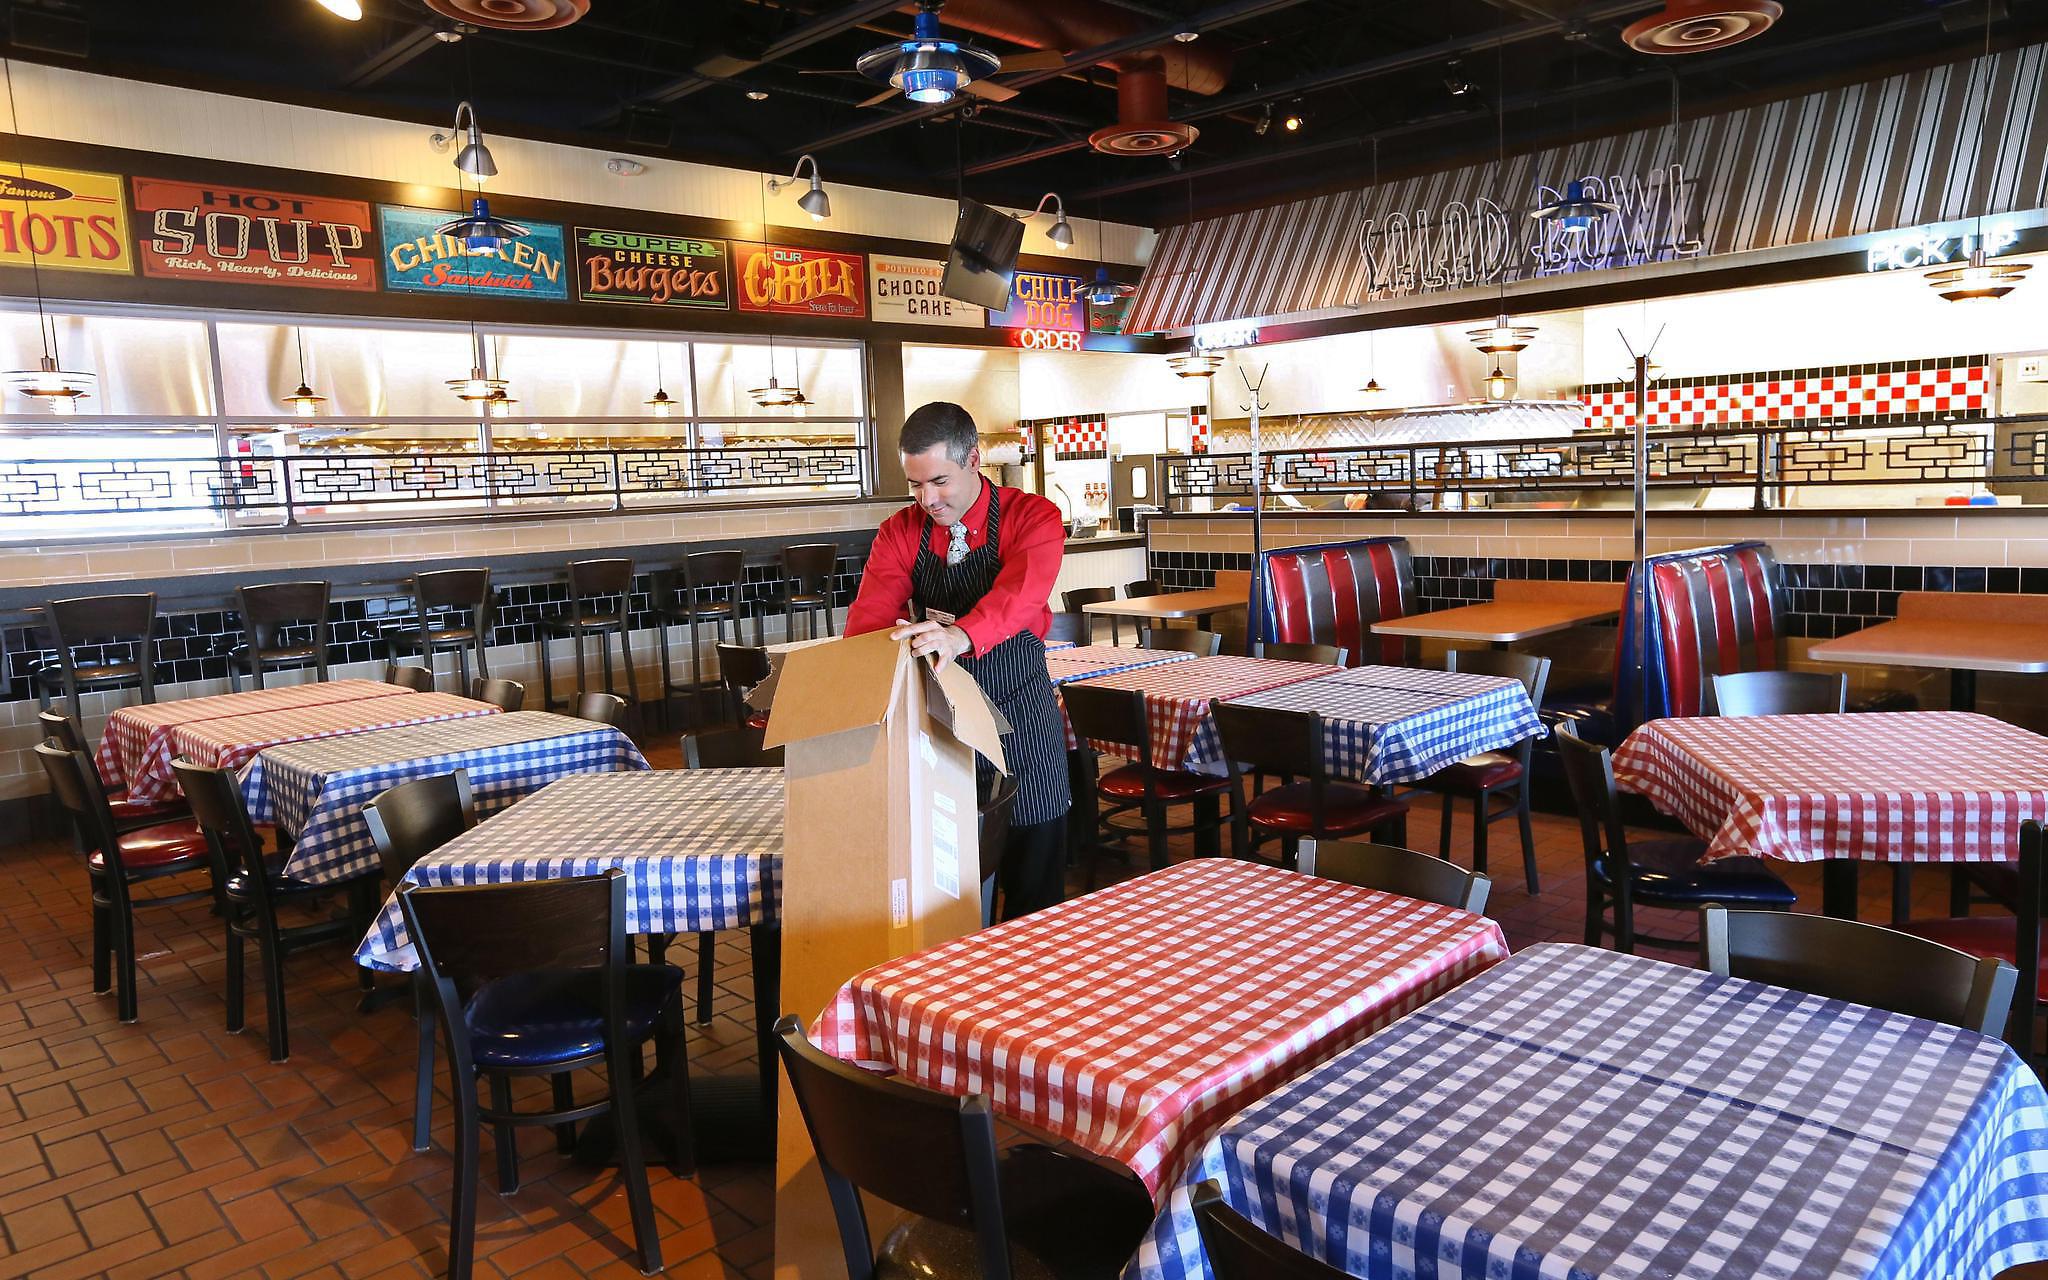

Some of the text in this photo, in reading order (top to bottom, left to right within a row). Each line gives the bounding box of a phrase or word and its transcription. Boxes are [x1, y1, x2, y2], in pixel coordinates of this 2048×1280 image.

[0, 180, 56, 199] Famous
[202, 191, 312, 214] HOT
[152, 207, 363, 267] SOUP
[1360, 164, 1701, 292] SALAD BOWL
[600, 234, 703, 253] SUPER
[1867, 222, 2018, 272] PICK UP
[615, 250, 693, 267] CHEESE
[774, 250, 802, 262] OUR
[165, 258, 212, 272] Rich,
[287, 267, 358, 281] Delicious
[423, 264, 534, 289] Sandwich
[586, 255, 720, 303] Burgers
[743, 252, 859, 306] CHILI
[1016, 274, 1077, 303] CHILI
[908, 299, 951, 315] CAKE
[1024, 301, 1073, 328] DOG
[1021, 328, 1080, 351] ORDER
